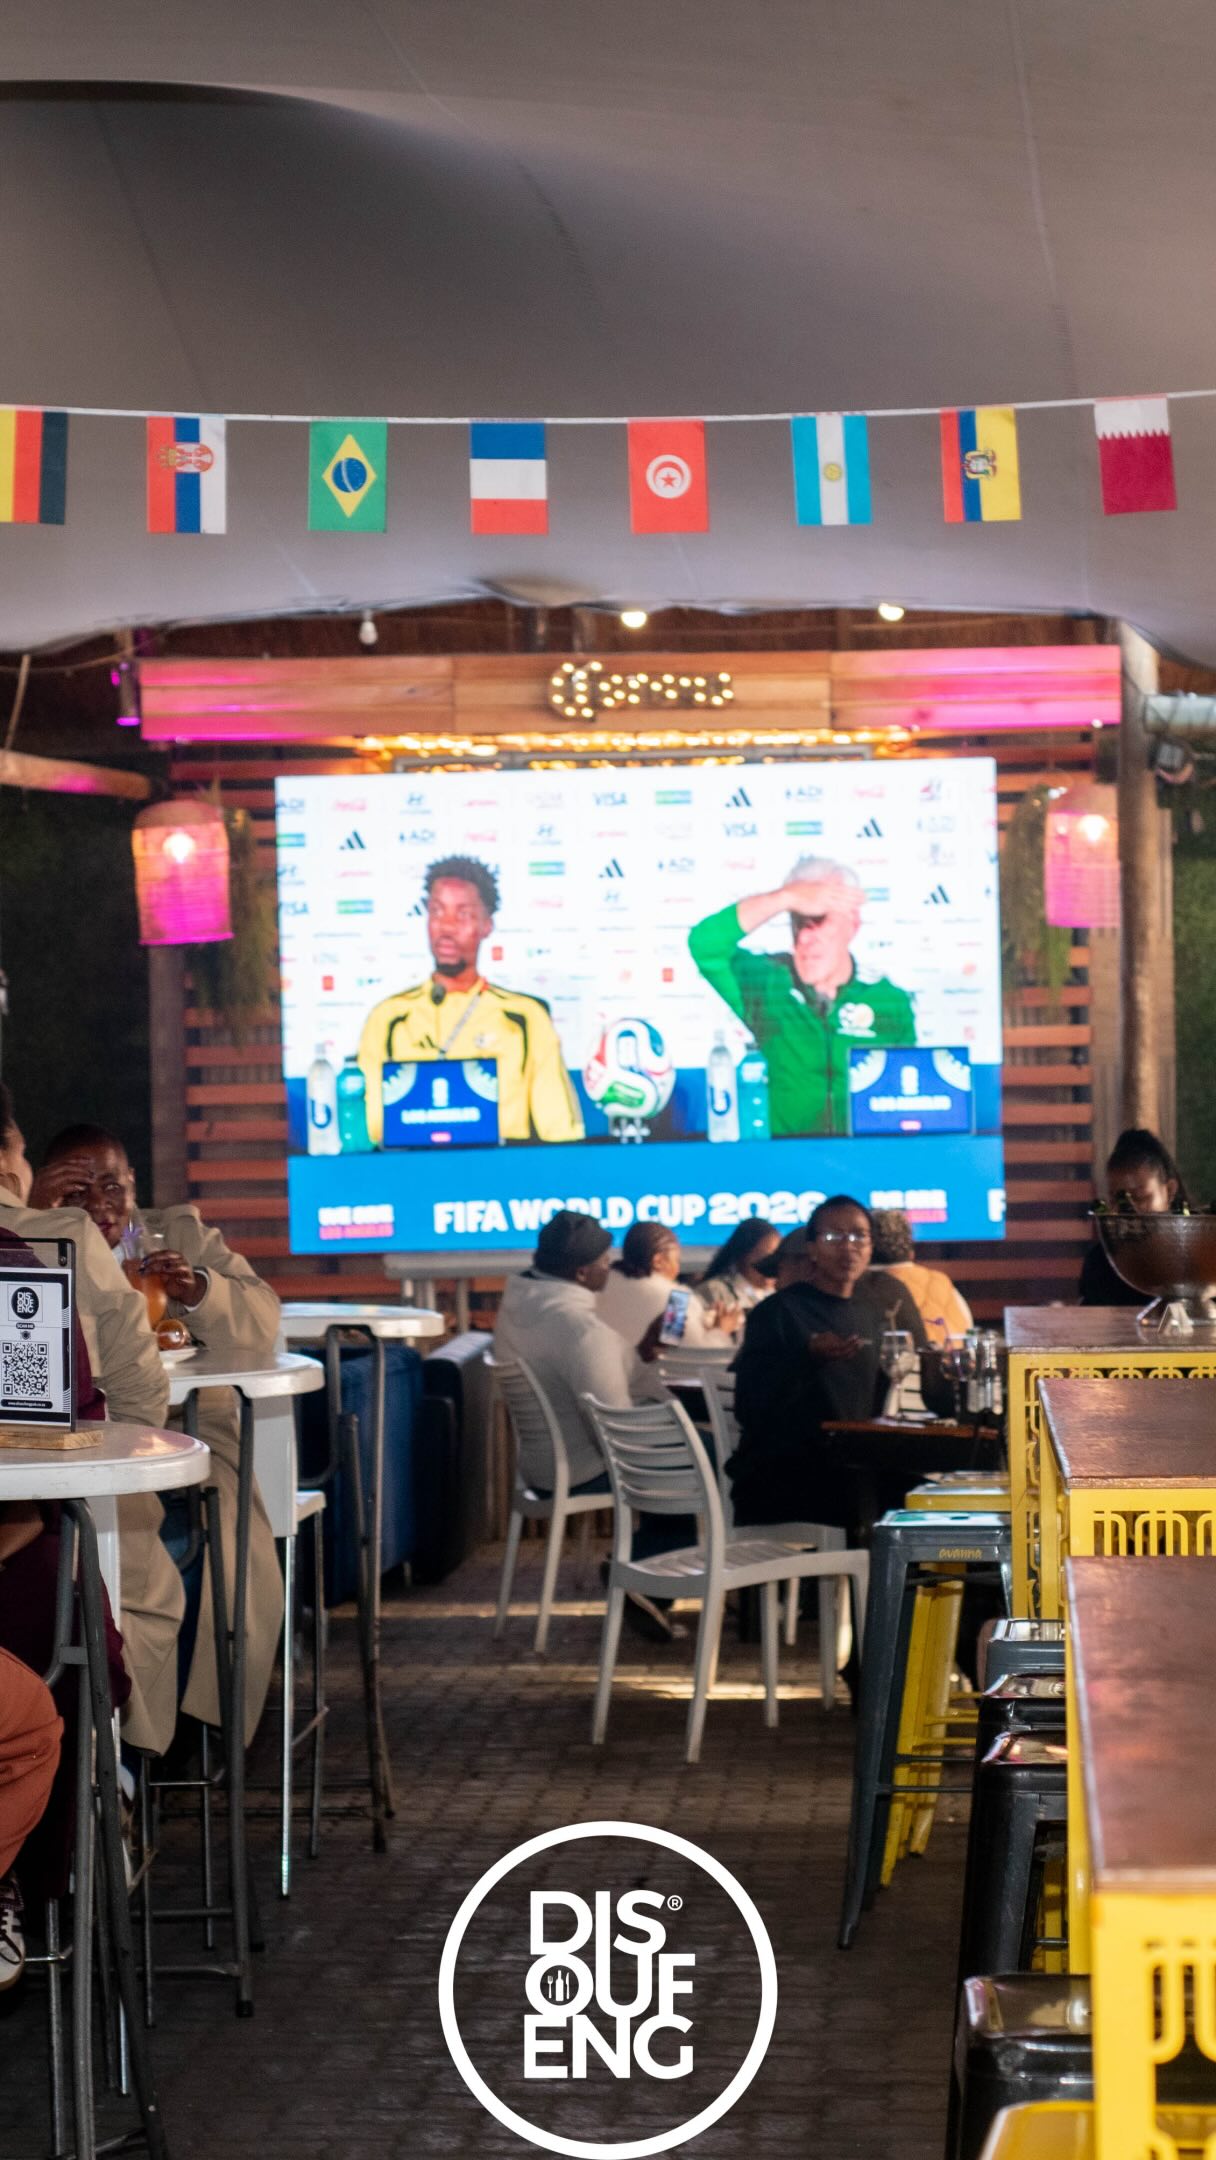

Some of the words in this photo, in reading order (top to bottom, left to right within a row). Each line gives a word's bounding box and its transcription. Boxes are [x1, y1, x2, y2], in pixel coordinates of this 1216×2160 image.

[433, 1200, 509, 1235] FIFA
[636, 1194, 706, 1227] CUP
[708, 1190, 828, 1226] 2026
